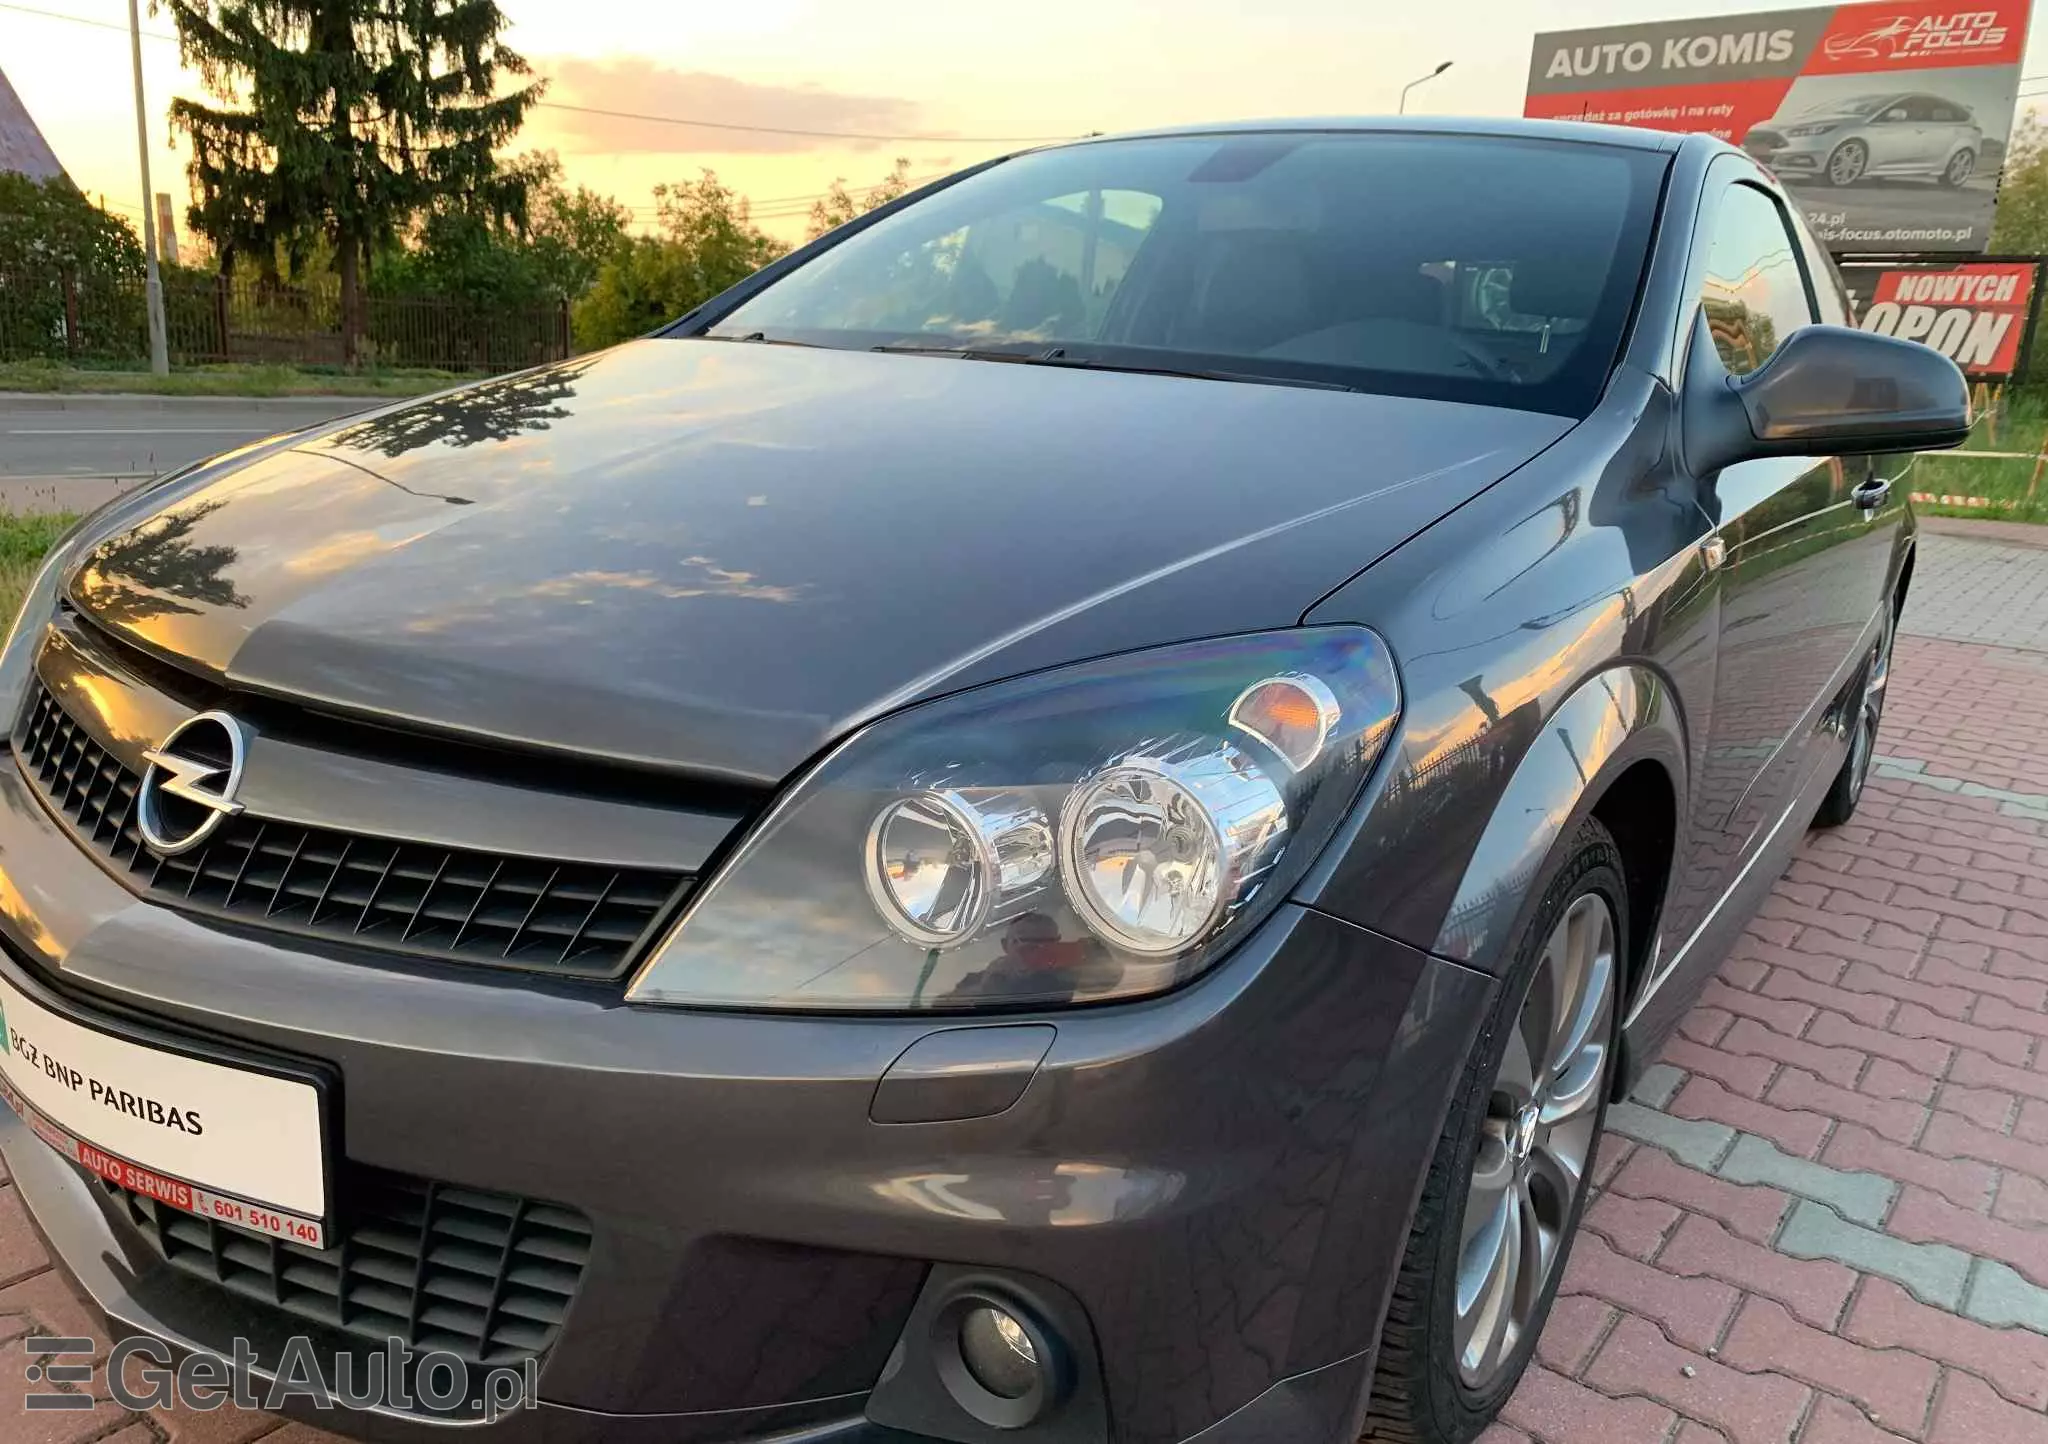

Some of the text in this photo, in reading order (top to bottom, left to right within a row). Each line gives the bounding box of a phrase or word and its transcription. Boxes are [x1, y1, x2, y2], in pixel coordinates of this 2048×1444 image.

[1904, 27, 2008, 50] FOCUS
[1911, 11, 1997, 32] AUTO
[1545, 29, 1795, 78] AUTO KOMIS
[1607, 112, 1621, 121] za
[1624, 105, 1678, 123] gotówkę
[1688, 106, 1704, 116] na
[1707, 104, 1735, 118] raty
[1895, 274, 2020, 302] NOWYCH
[1860, 301, 2014, 366] OPON
[43, 1053, 83, 1092] BNP
[89, 1078, 203, 1136] PARIBAS
[82, 1147, 188, 1205] AUTO SERWIS
[214, 1201, 318, 1243] 601 510 140
